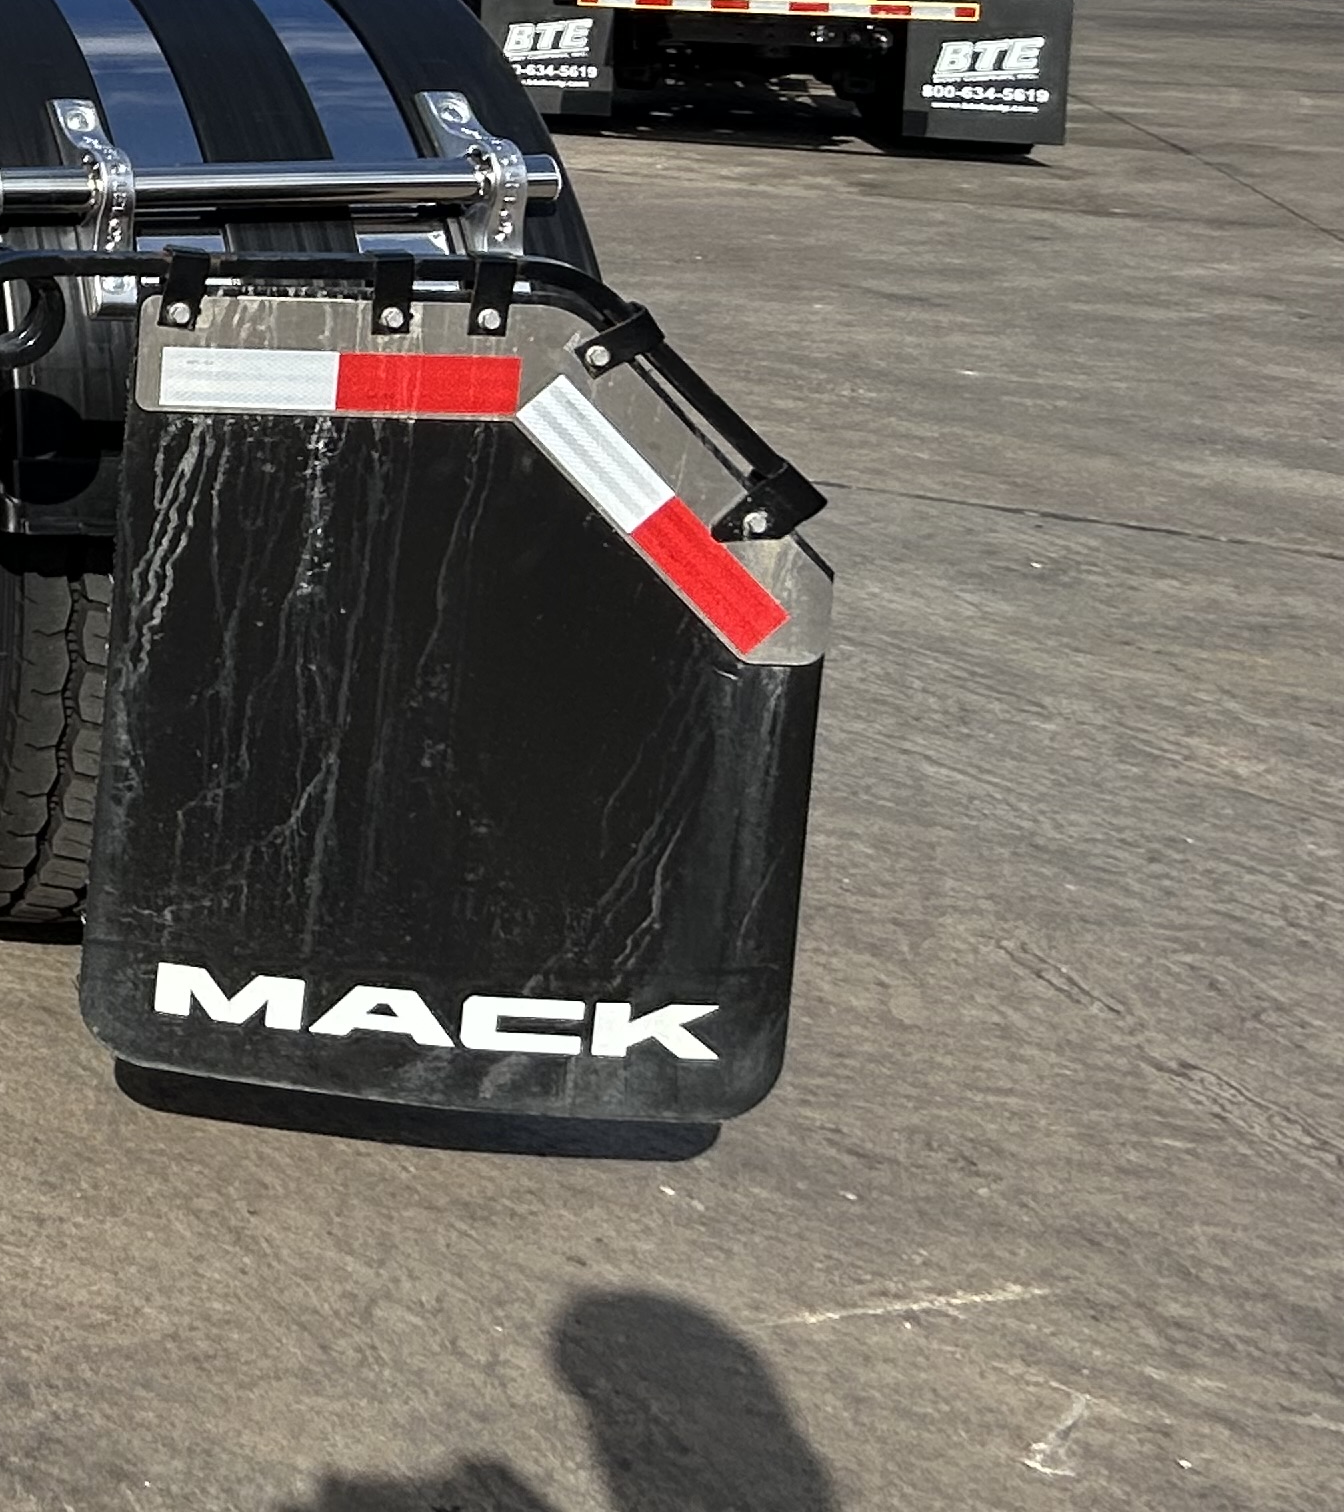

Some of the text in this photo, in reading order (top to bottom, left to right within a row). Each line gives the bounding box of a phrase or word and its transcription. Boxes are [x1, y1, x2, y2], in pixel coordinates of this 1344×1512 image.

[503, 18, 593, 53] BTE
[933, 36, 1045, 74] BTE
[153, 961, 720, 1061] MACK
